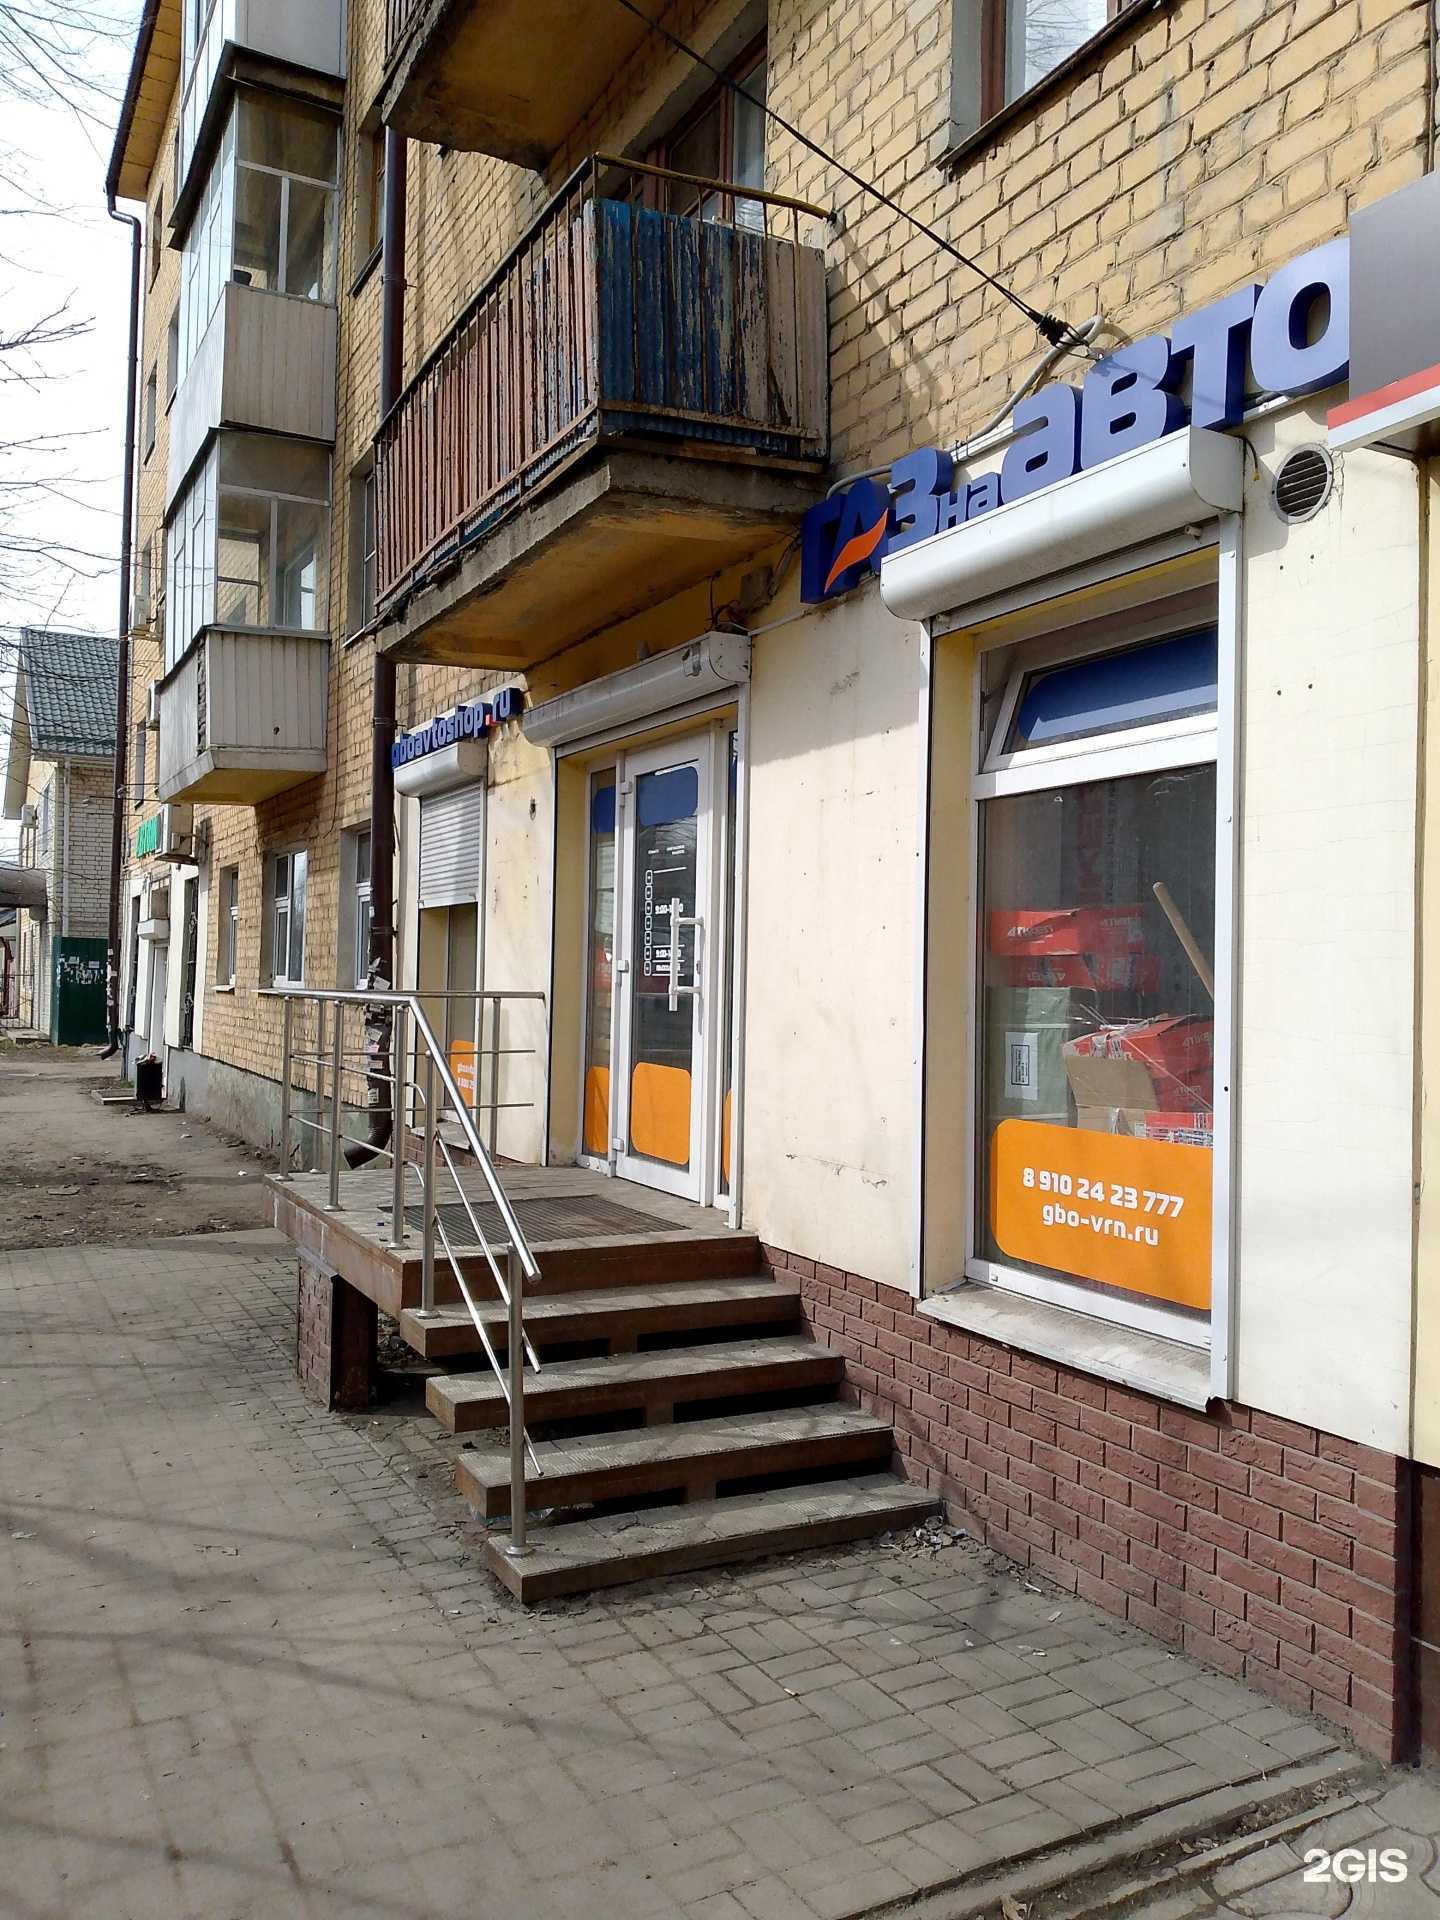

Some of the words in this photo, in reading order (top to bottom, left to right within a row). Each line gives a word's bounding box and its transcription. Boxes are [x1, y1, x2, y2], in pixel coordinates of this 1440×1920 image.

[800, 447, 953, 604] ГАЗ
[938, 471, 1000, 533] на
[1023, 1167, 1035, 1187] 8
[1039, 1170, 1072, 1196] 910
[1076, 1178, 1105, 1202] 24
[1110, 1184, 1138, 1209] 23
[1142, 1190, 1185, 1218] 777
[1042, 1203, 1159, 1246] gbo-vrn.ru
